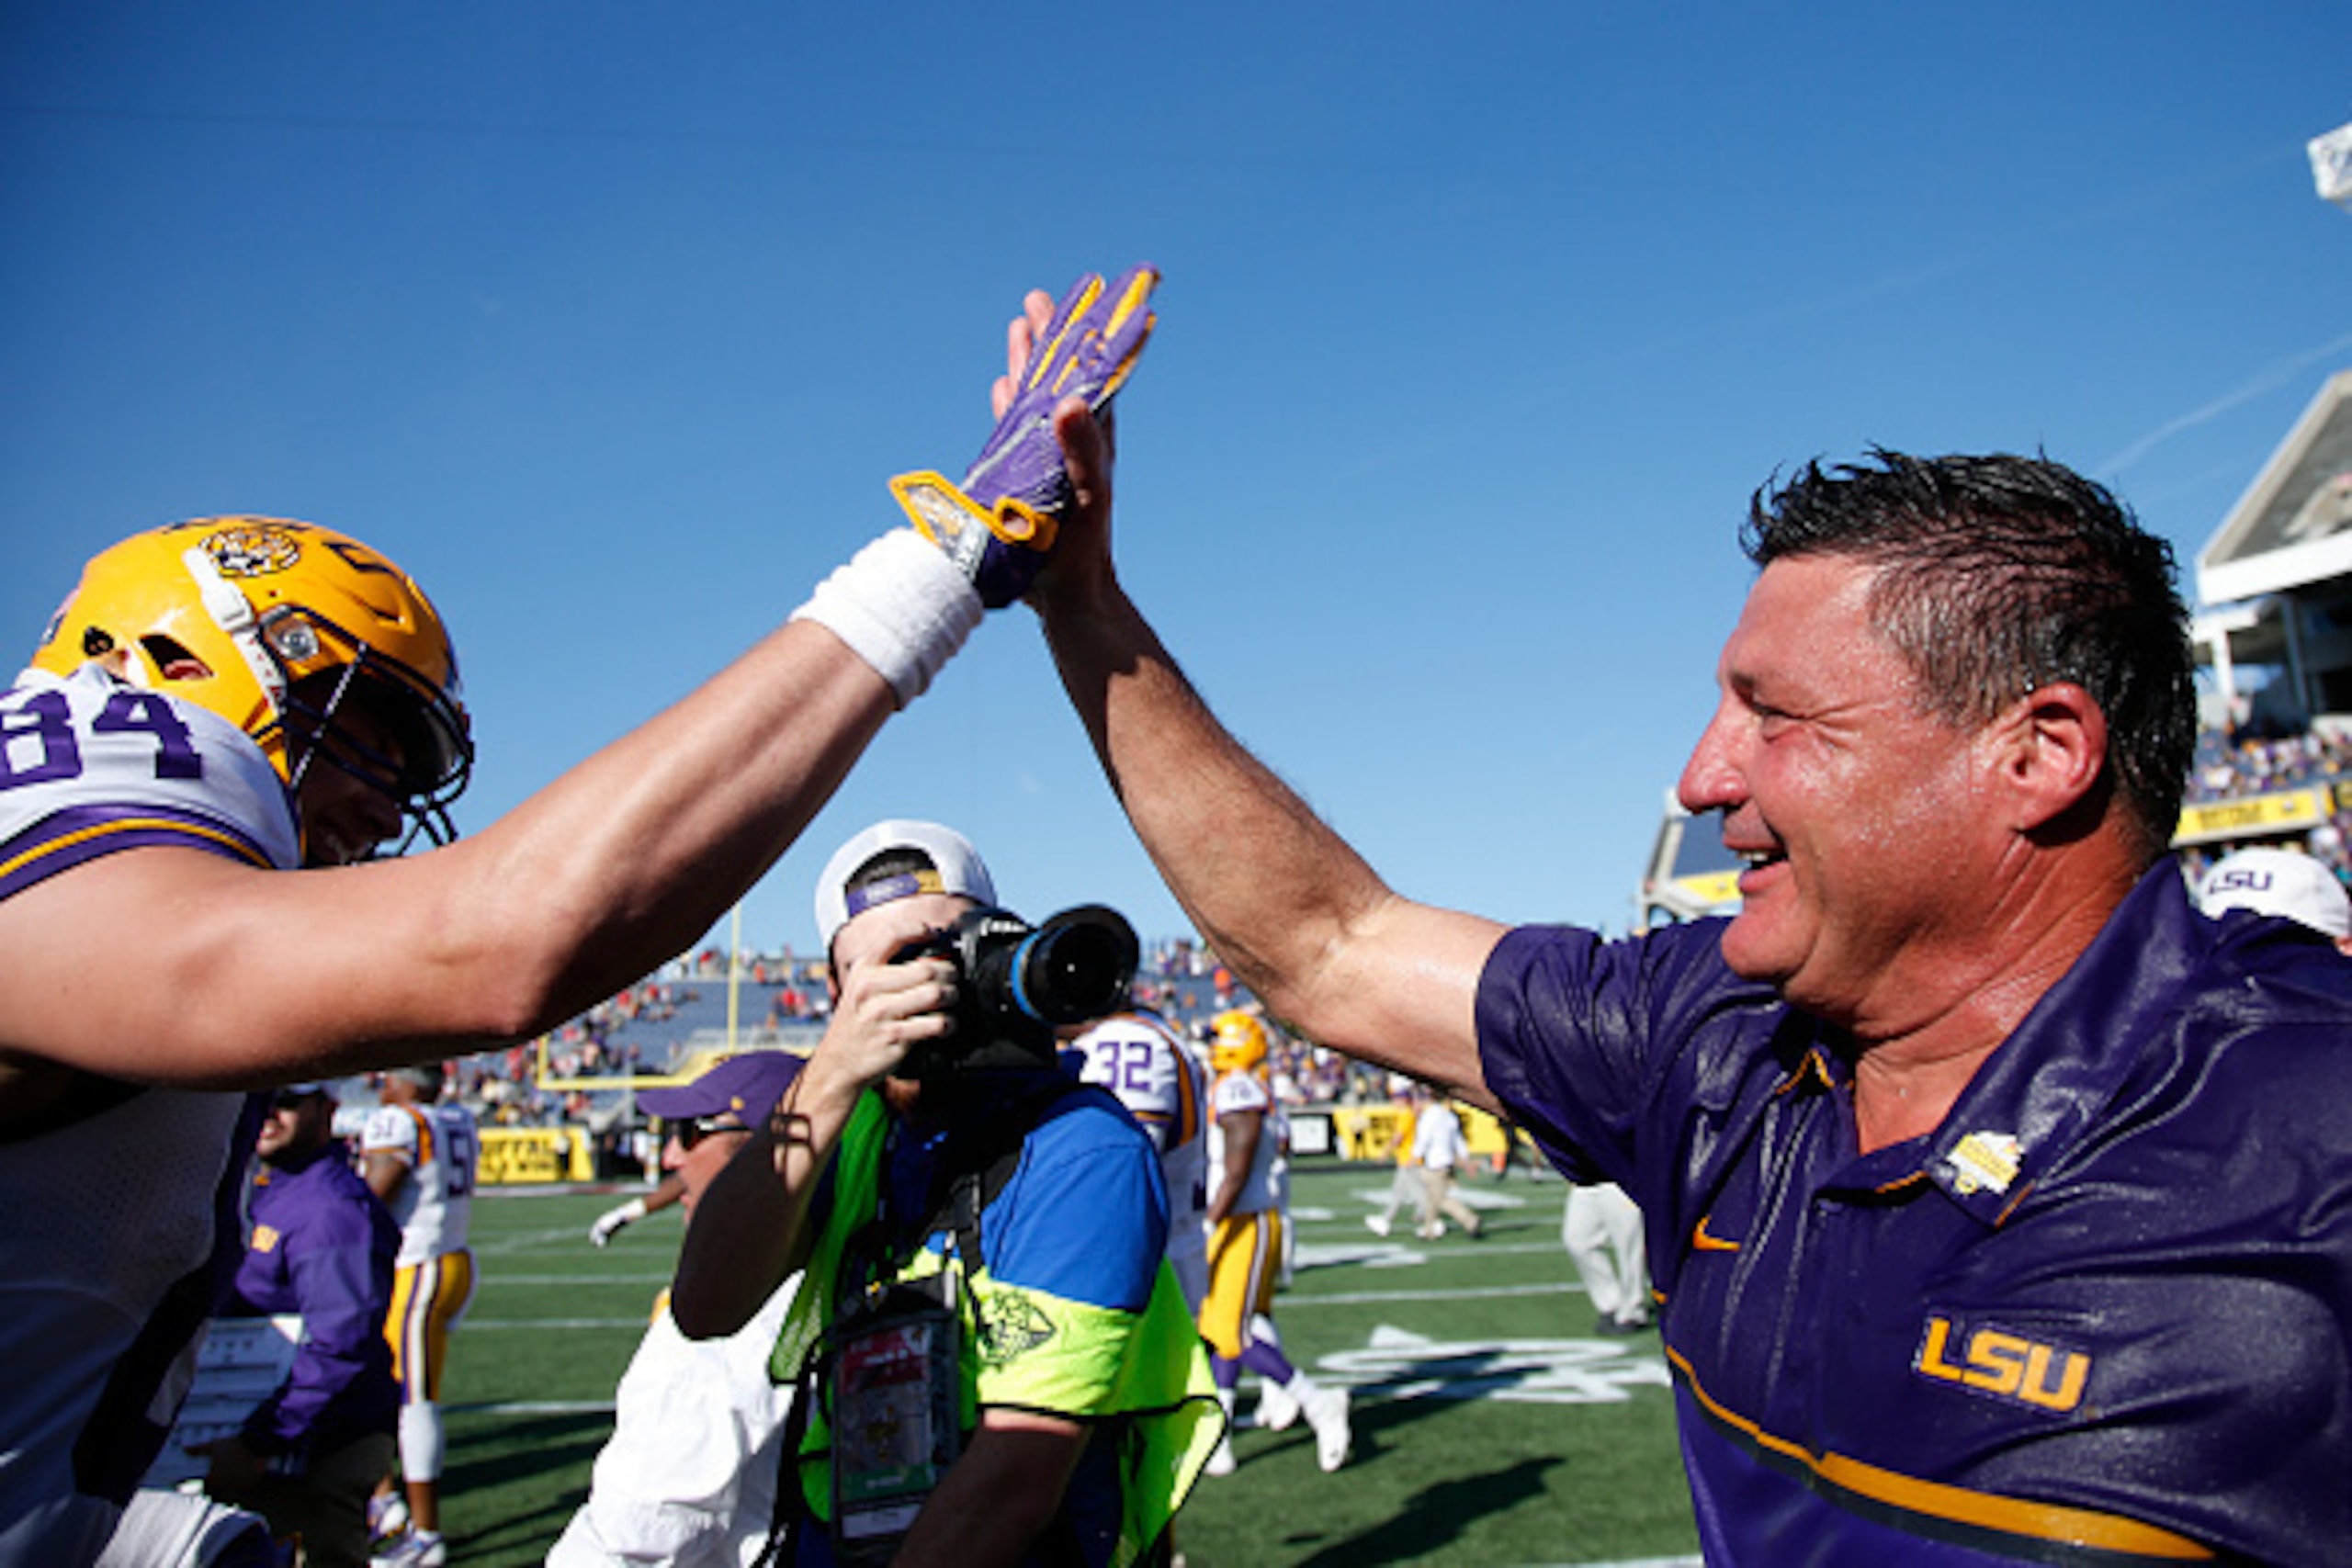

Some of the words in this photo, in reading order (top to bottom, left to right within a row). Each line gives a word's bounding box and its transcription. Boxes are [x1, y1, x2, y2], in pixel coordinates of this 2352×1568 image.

[0, 690, 202, 792] 84
[2208, 871, 2272, 896] LSU
[1096, 1041, 1152, 1092] 32
[1918, 1316, 2092, 1413] LSU
